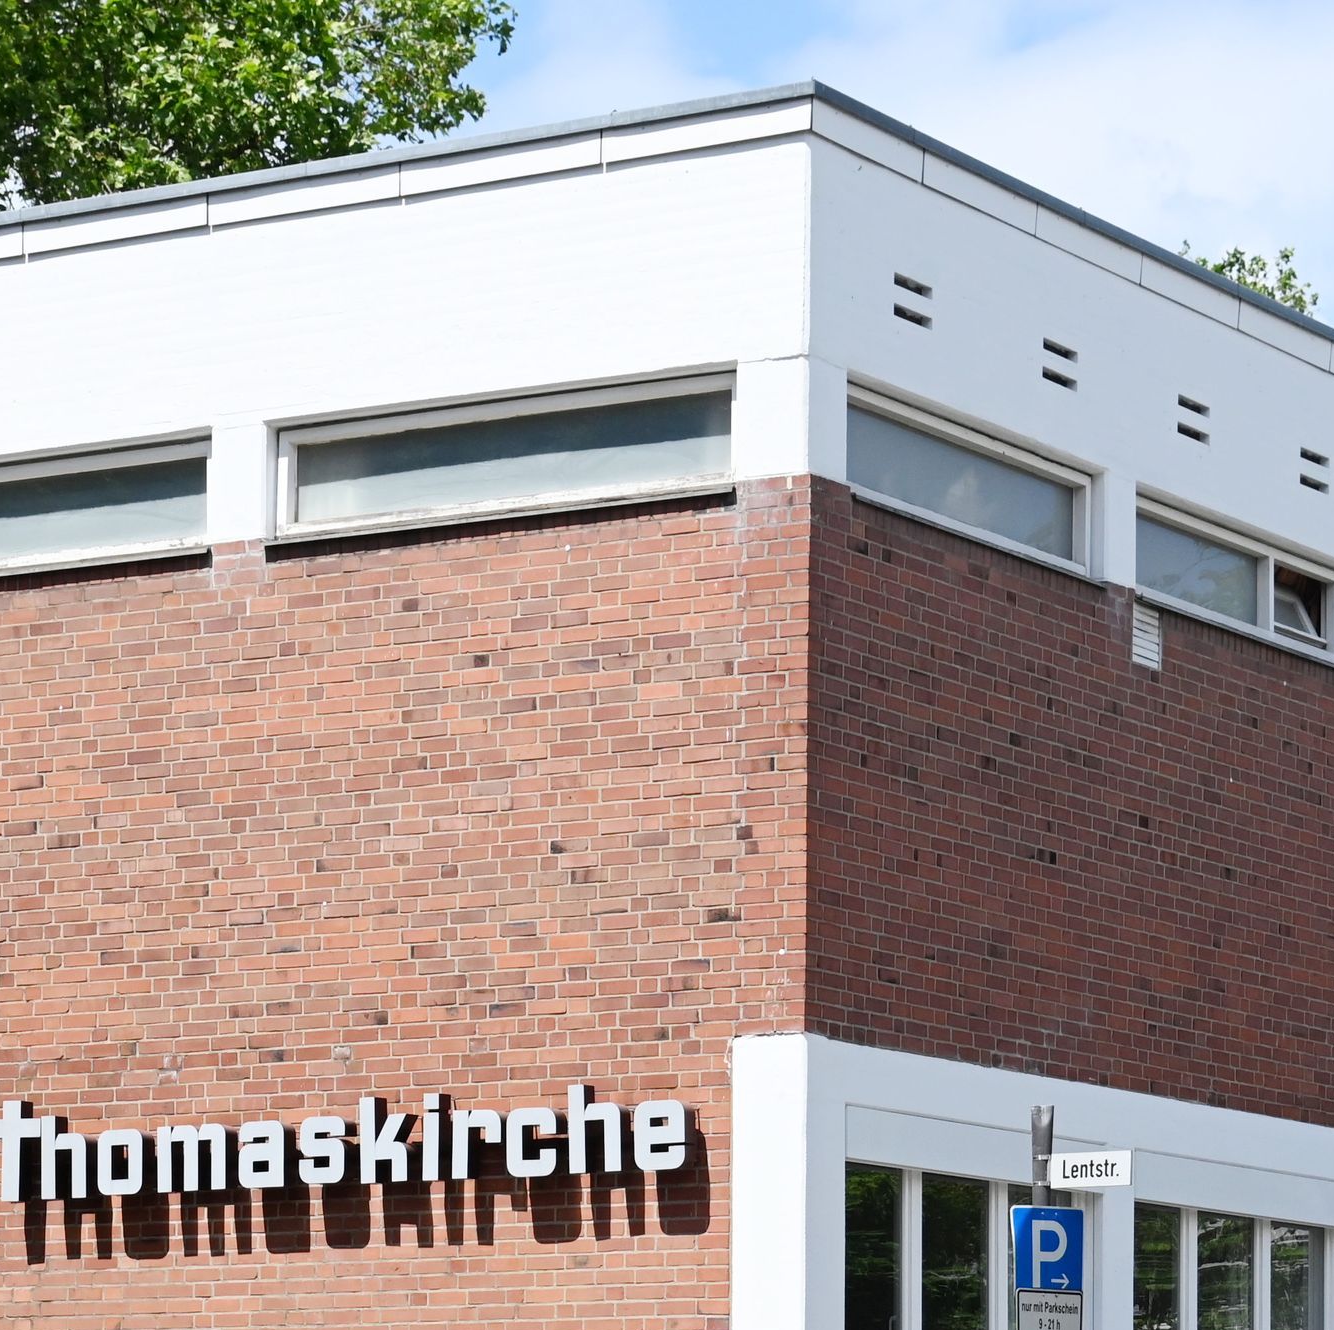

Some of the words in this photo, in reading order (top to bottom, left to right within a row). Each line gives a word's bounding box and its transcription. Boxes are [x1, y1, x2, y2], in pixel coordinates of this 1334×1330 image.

[1062, 1159, 1119, 1179] Lentstr.
[1032, 1220, 1067, 1288] P
[1021, 1303, 1033, 1312] nur
[1033, 1302, 1044, 1313] mit
[1044, 1301, 1078, 1315] Parkschein
[1038, 1319, 1043, 1329] 9
[1048, 1319, 1055, 1330] 21
[1056, 1319, 1060, 1330] h
